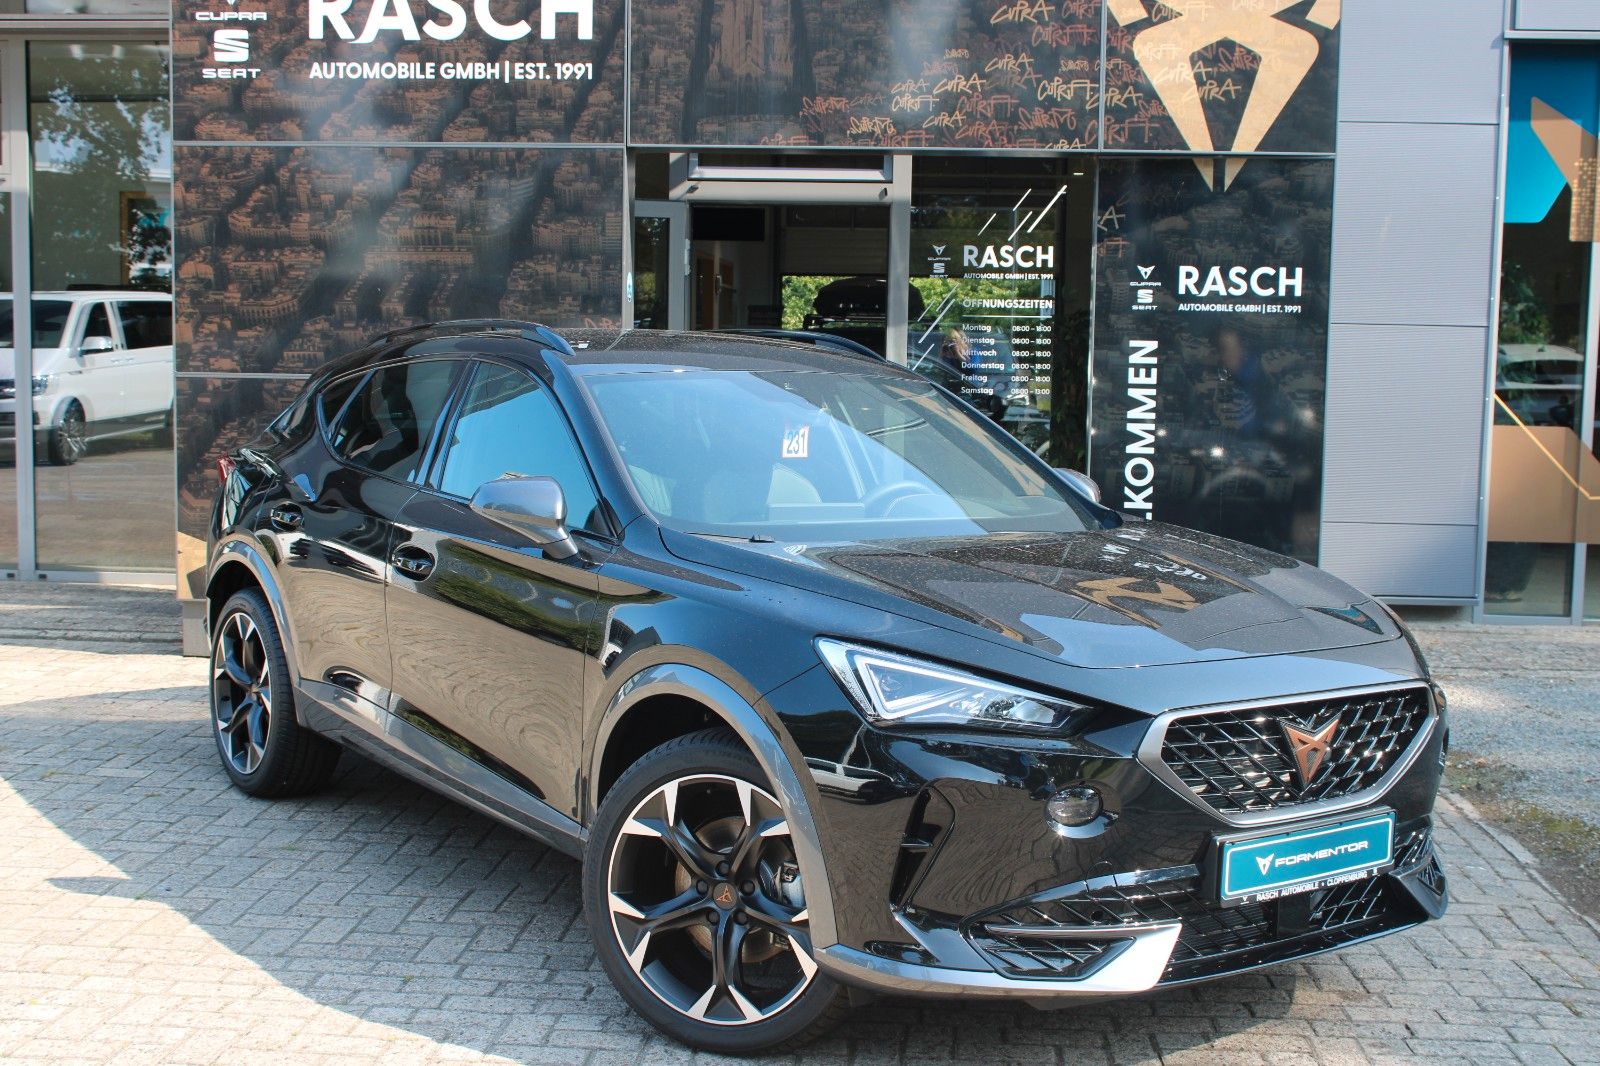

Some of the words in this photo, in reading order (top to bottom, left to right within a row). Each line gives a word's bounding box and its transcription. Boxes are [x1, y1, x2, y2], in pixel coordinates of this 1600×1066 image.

[195, 11, 267, 21] CUPRA
[309, 0, 594, 44] RASCH
[202, 68, 260, 79] SEAT
[309, 62, 435, 80] AUTOMOBILE
[439, 62, 500, 80] GMBH
[514, 62, 550, 80] EST.
[555, 62, 593, 80] 1991
[963, 245, 1054, 269] RASCH
[1178, 265, 1303, 297] RASCH
[963, 297, 1053, 309] ÖFFNUNGSZEITEN
[1178, 303, 1233, 312] AUTOMOBILE
[1235, 304, 1261, 313] GMBH
[1267, 305, 1283, 313] EST.
[1284, 305, 1302, 313] 1991
[962, 324, 992, 333] Montag
[962, 337, 995, 345] Dienstag
[961, 362, 1005, 371] Donnerstag
[961, 374, 988, 382] Freitag
[961, 387, 994, 396] Samstag
[1124, 340, 1159, 520] KOMMEN
[1275, 840, 1368, 867] FORMENTOR
[1256, 891, 1279, 902] RASCH
[1281, 881, 1320, 897] AUTOMOBILE
[1327, 871, 1368, 887] CLOPPENBURG
